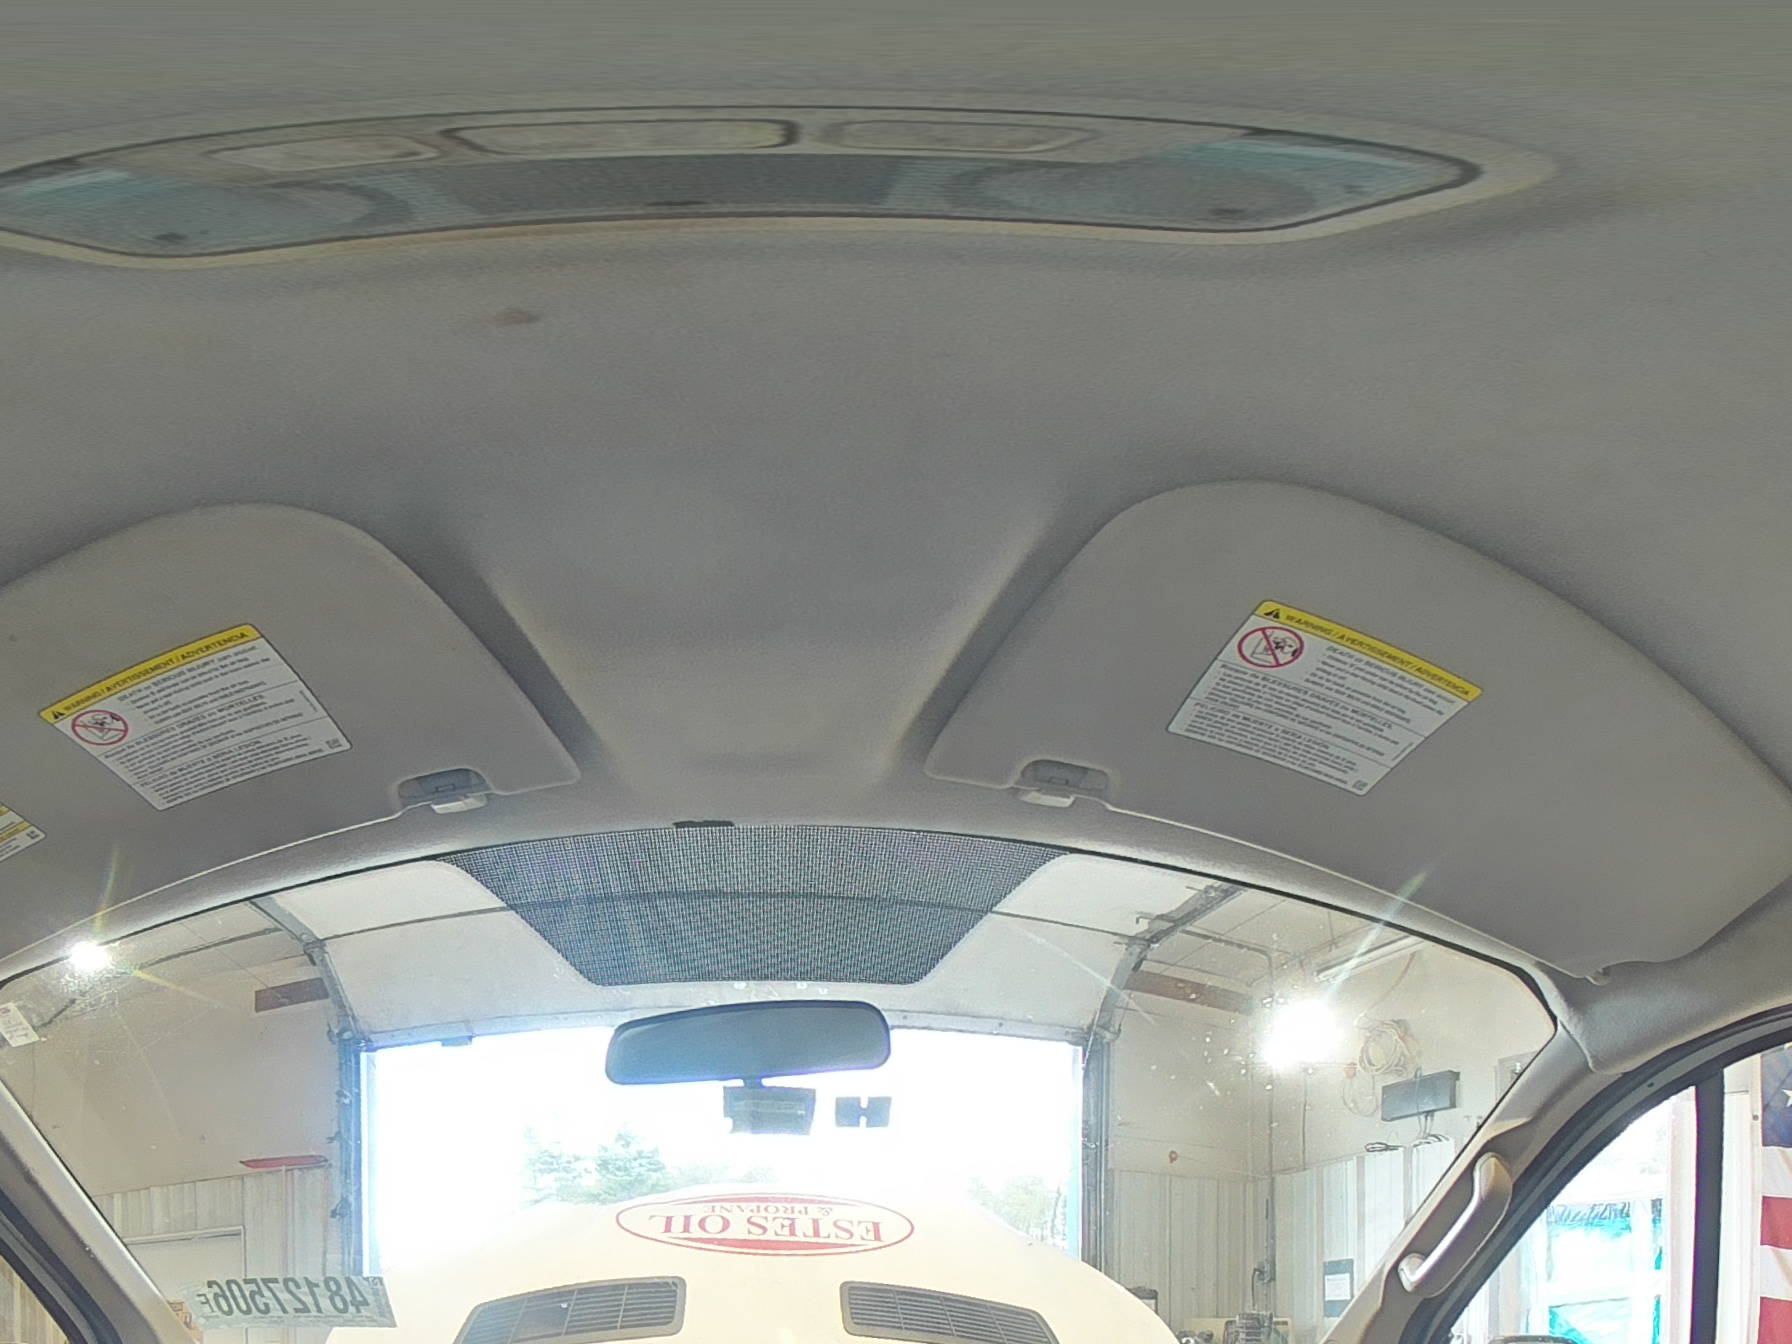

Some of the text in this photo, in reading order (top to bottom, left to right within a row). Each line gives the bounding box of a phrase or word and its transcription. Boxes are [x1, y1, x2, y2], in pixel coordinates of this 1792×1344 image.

[1285, 614, 1333, 636] WARNING
[63, 691, 101, 711] WARNING
[704, 1204, 810, 1216] PROPANE
[649, 1214, 885, 1242] ESTES OIL
